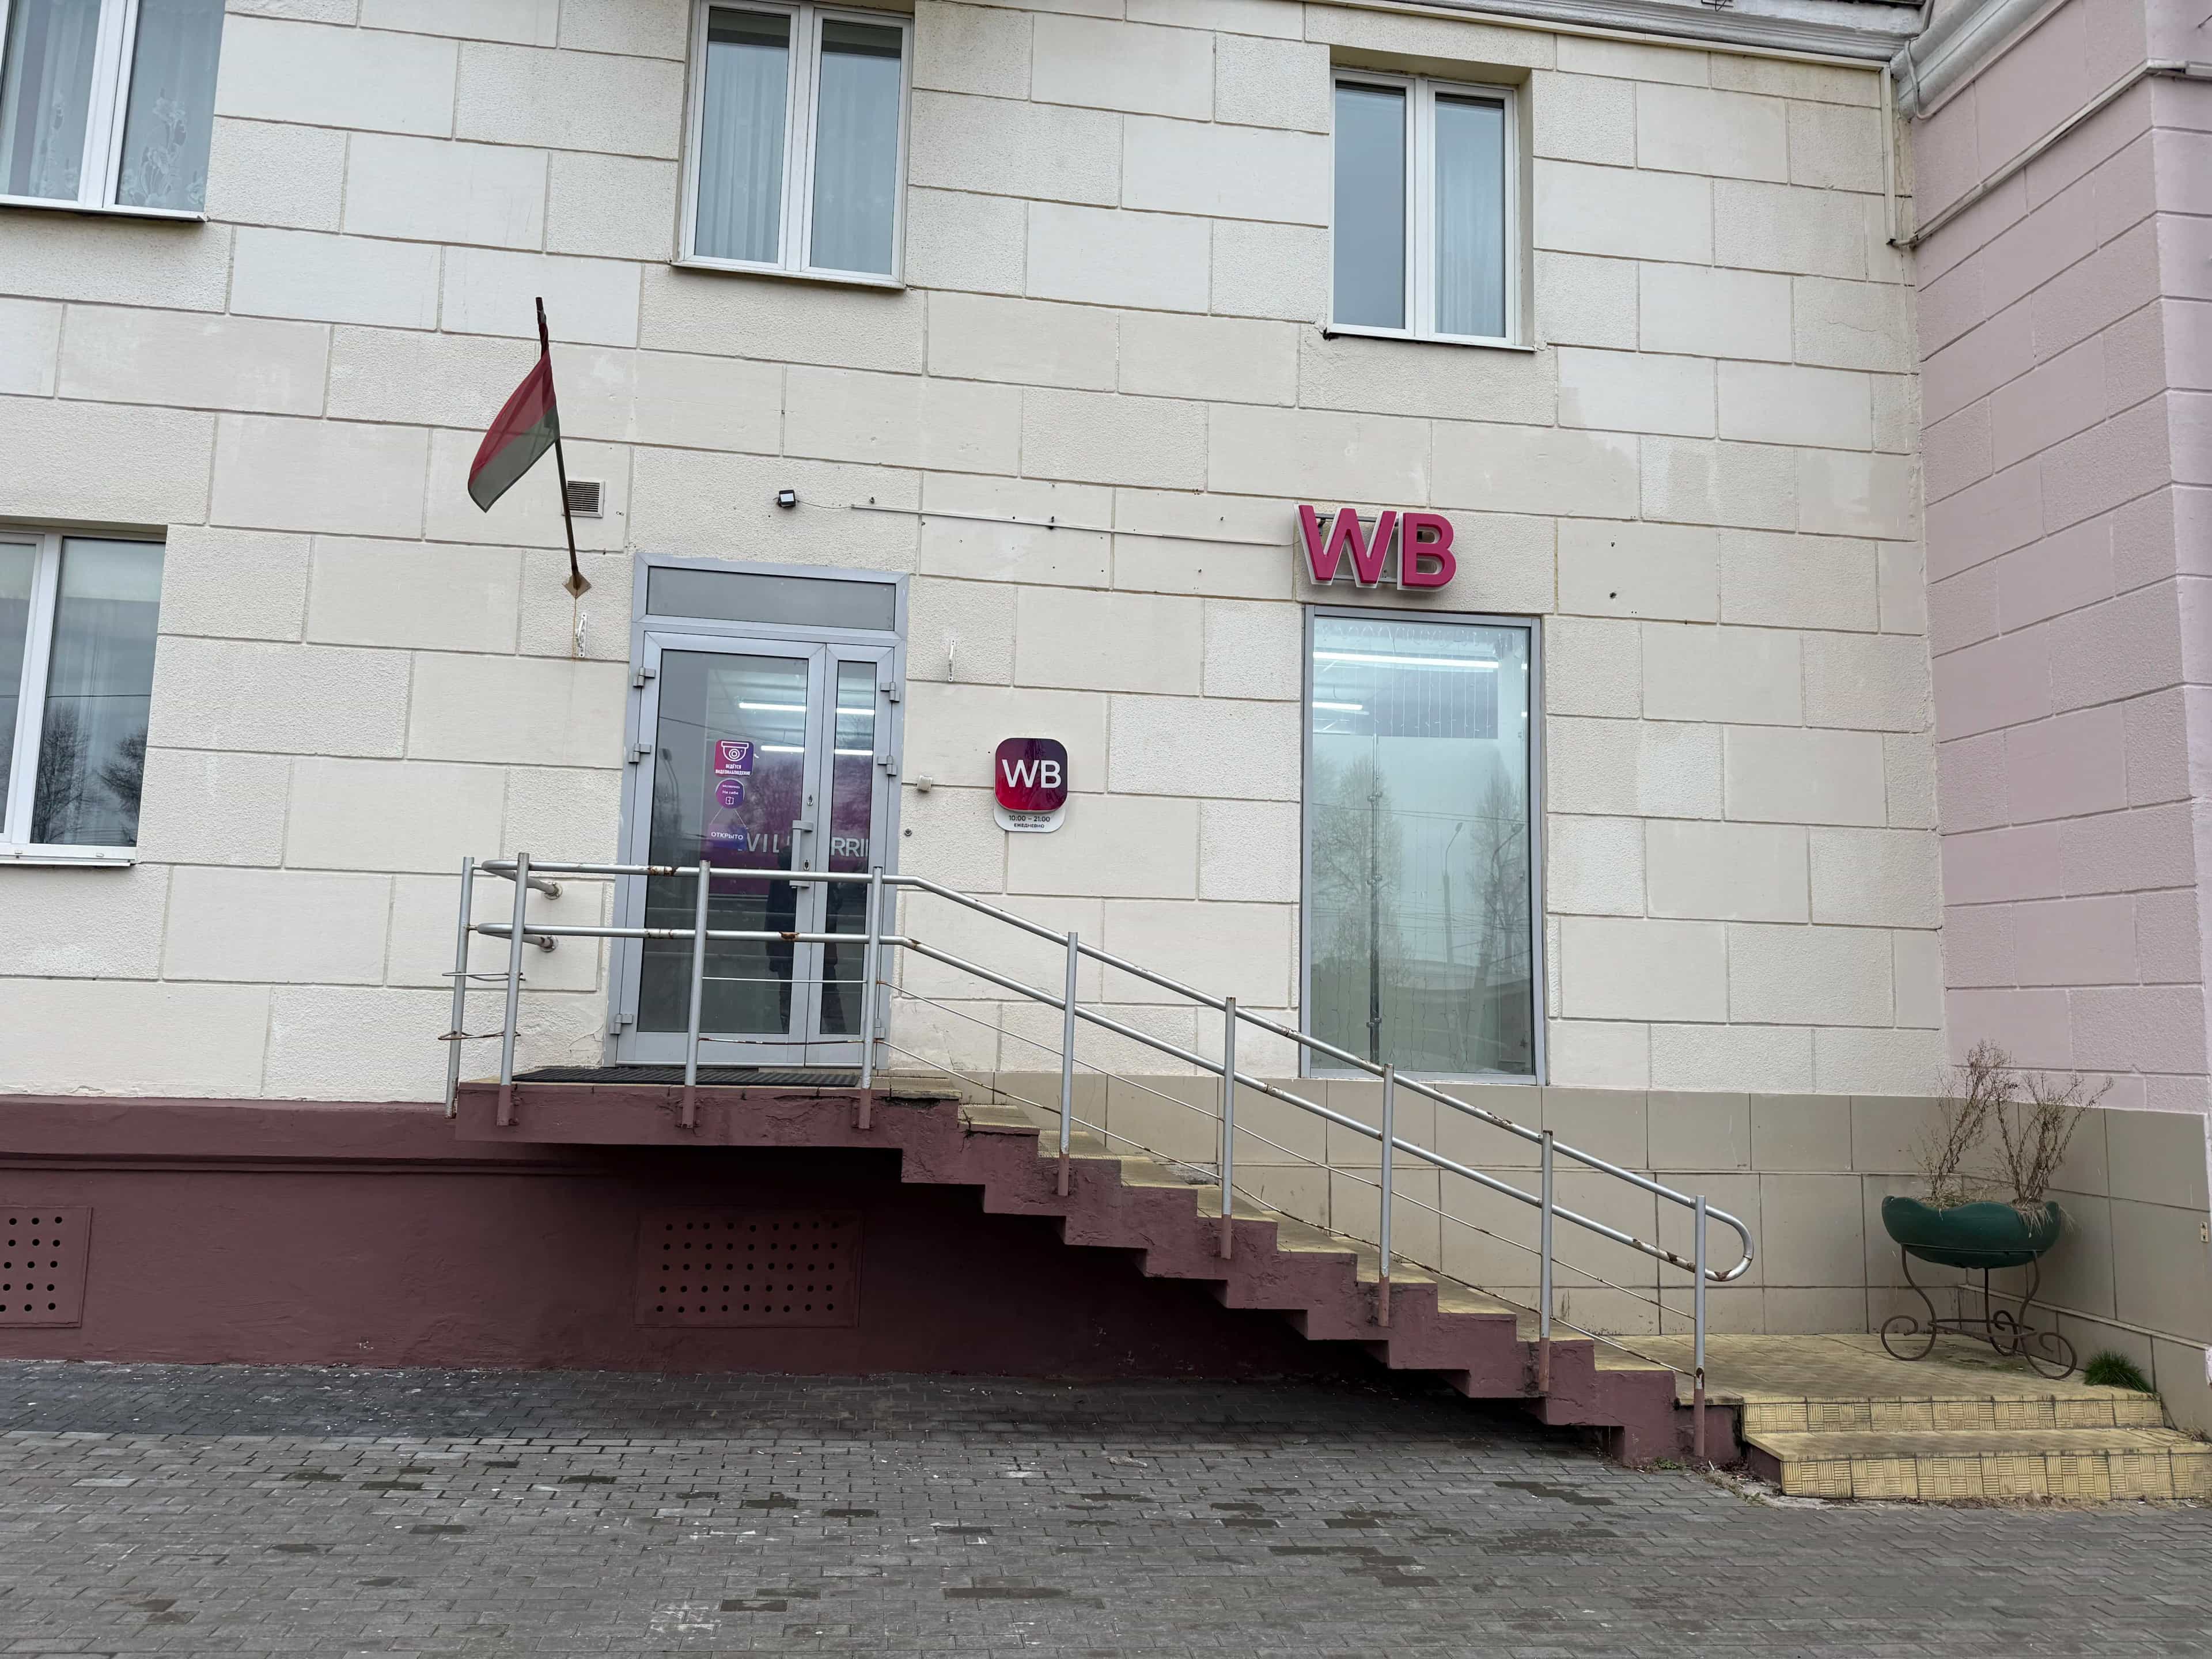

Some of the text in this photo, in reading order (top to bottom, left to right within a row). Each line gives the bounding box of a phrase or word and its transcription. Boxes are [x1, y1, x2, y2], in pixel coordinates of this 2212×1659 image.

[1294, 503, 1457, 592] WB
[1001, 759, 1062, 788] WB
[711, 831, 743, 840] ОТКРЫТО
